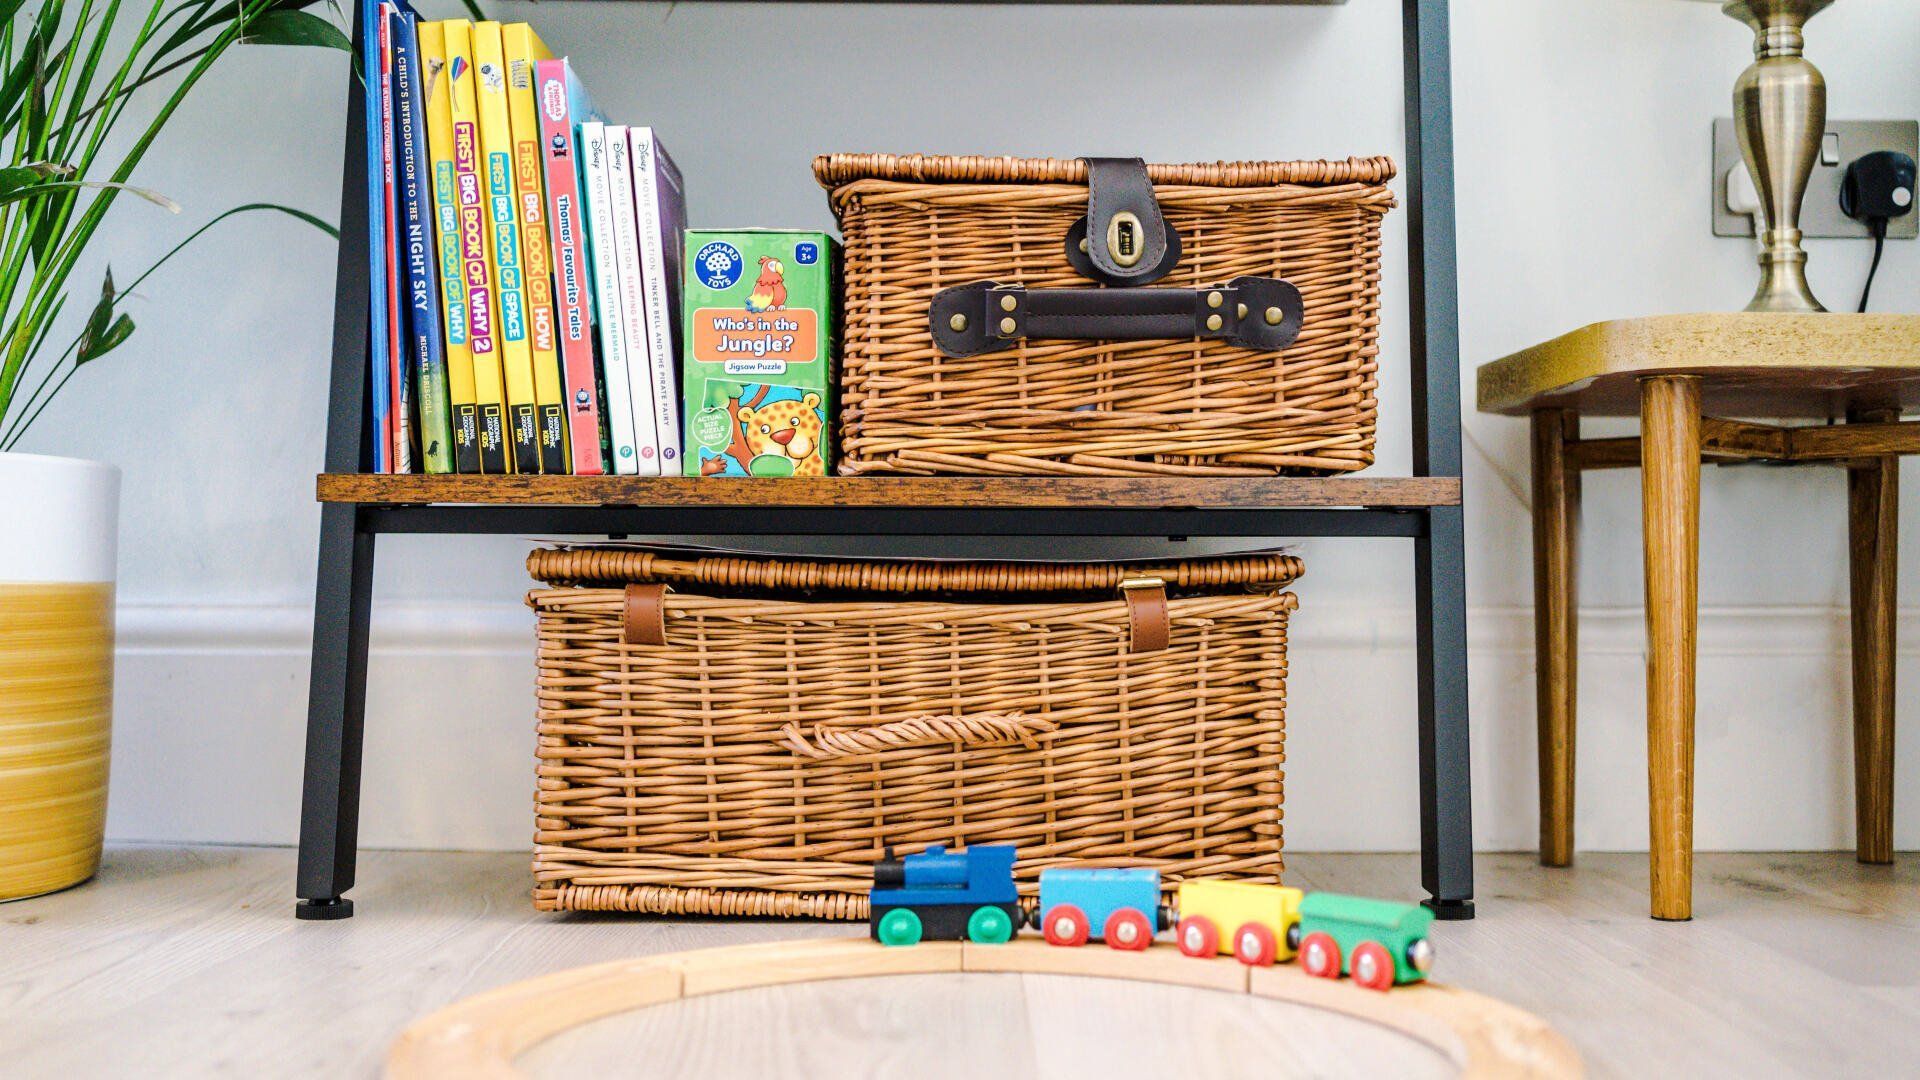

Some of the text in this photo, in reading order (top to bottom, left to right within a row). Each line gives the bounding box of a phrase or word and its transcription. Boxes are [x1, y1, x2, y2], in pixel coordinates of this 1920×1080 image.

[553, 84, 562, 117] THOMAS
[397, 46, 418, 220] A CHILD'S INTRODUCTION TO THE
[592, 136, 602, 169] Disney
[639, 140, 649, 172] Disney
[596, 176, 604, 204] MOVIE
[642, 178, 650, 206] MOVIE
[438, 163, 464, 340] FIRST BIG BOOK OF WHY
[456, 124, 490, 352] FIRST BIG BOOK OF WHY 2
[492, 154, 520, 338] FIRST BIG BOOK OF SPACE
[520, 143, 550, 350] FIRST BIG BOOK OF HOW
[599, 209, 610, 268] COLLECTION
[612, 138, 640, 350] Disney MOVIE COLLECTION SLEEPING BEAUTY
[644, 212, 656, 270] COLLECTION
[700, 244, 739, 261] ORCHARD
[409, 224, 428, 311] NIGHT SKY
[559, 196, 580, 338] Thomas' Favourite Tales
[708, 278, 731, 288] TOYS
[606, 292, 615, 318] LITTLE
[651, 278, 659, 307] TINKER
[713, 317, 798, 331] Who's in the
[610, 322, 619, 361] MERMAID
[716, 334, 794, 357] Jungle?
[420, 336, 432, 416] MICHAEL DRISCOLL
[729, 363, 756, 371] Jigsaw
[487, 417, 496, 451] GEOGRAPHIC
[521, 416, 529, 446] GEOGRAPHIC
